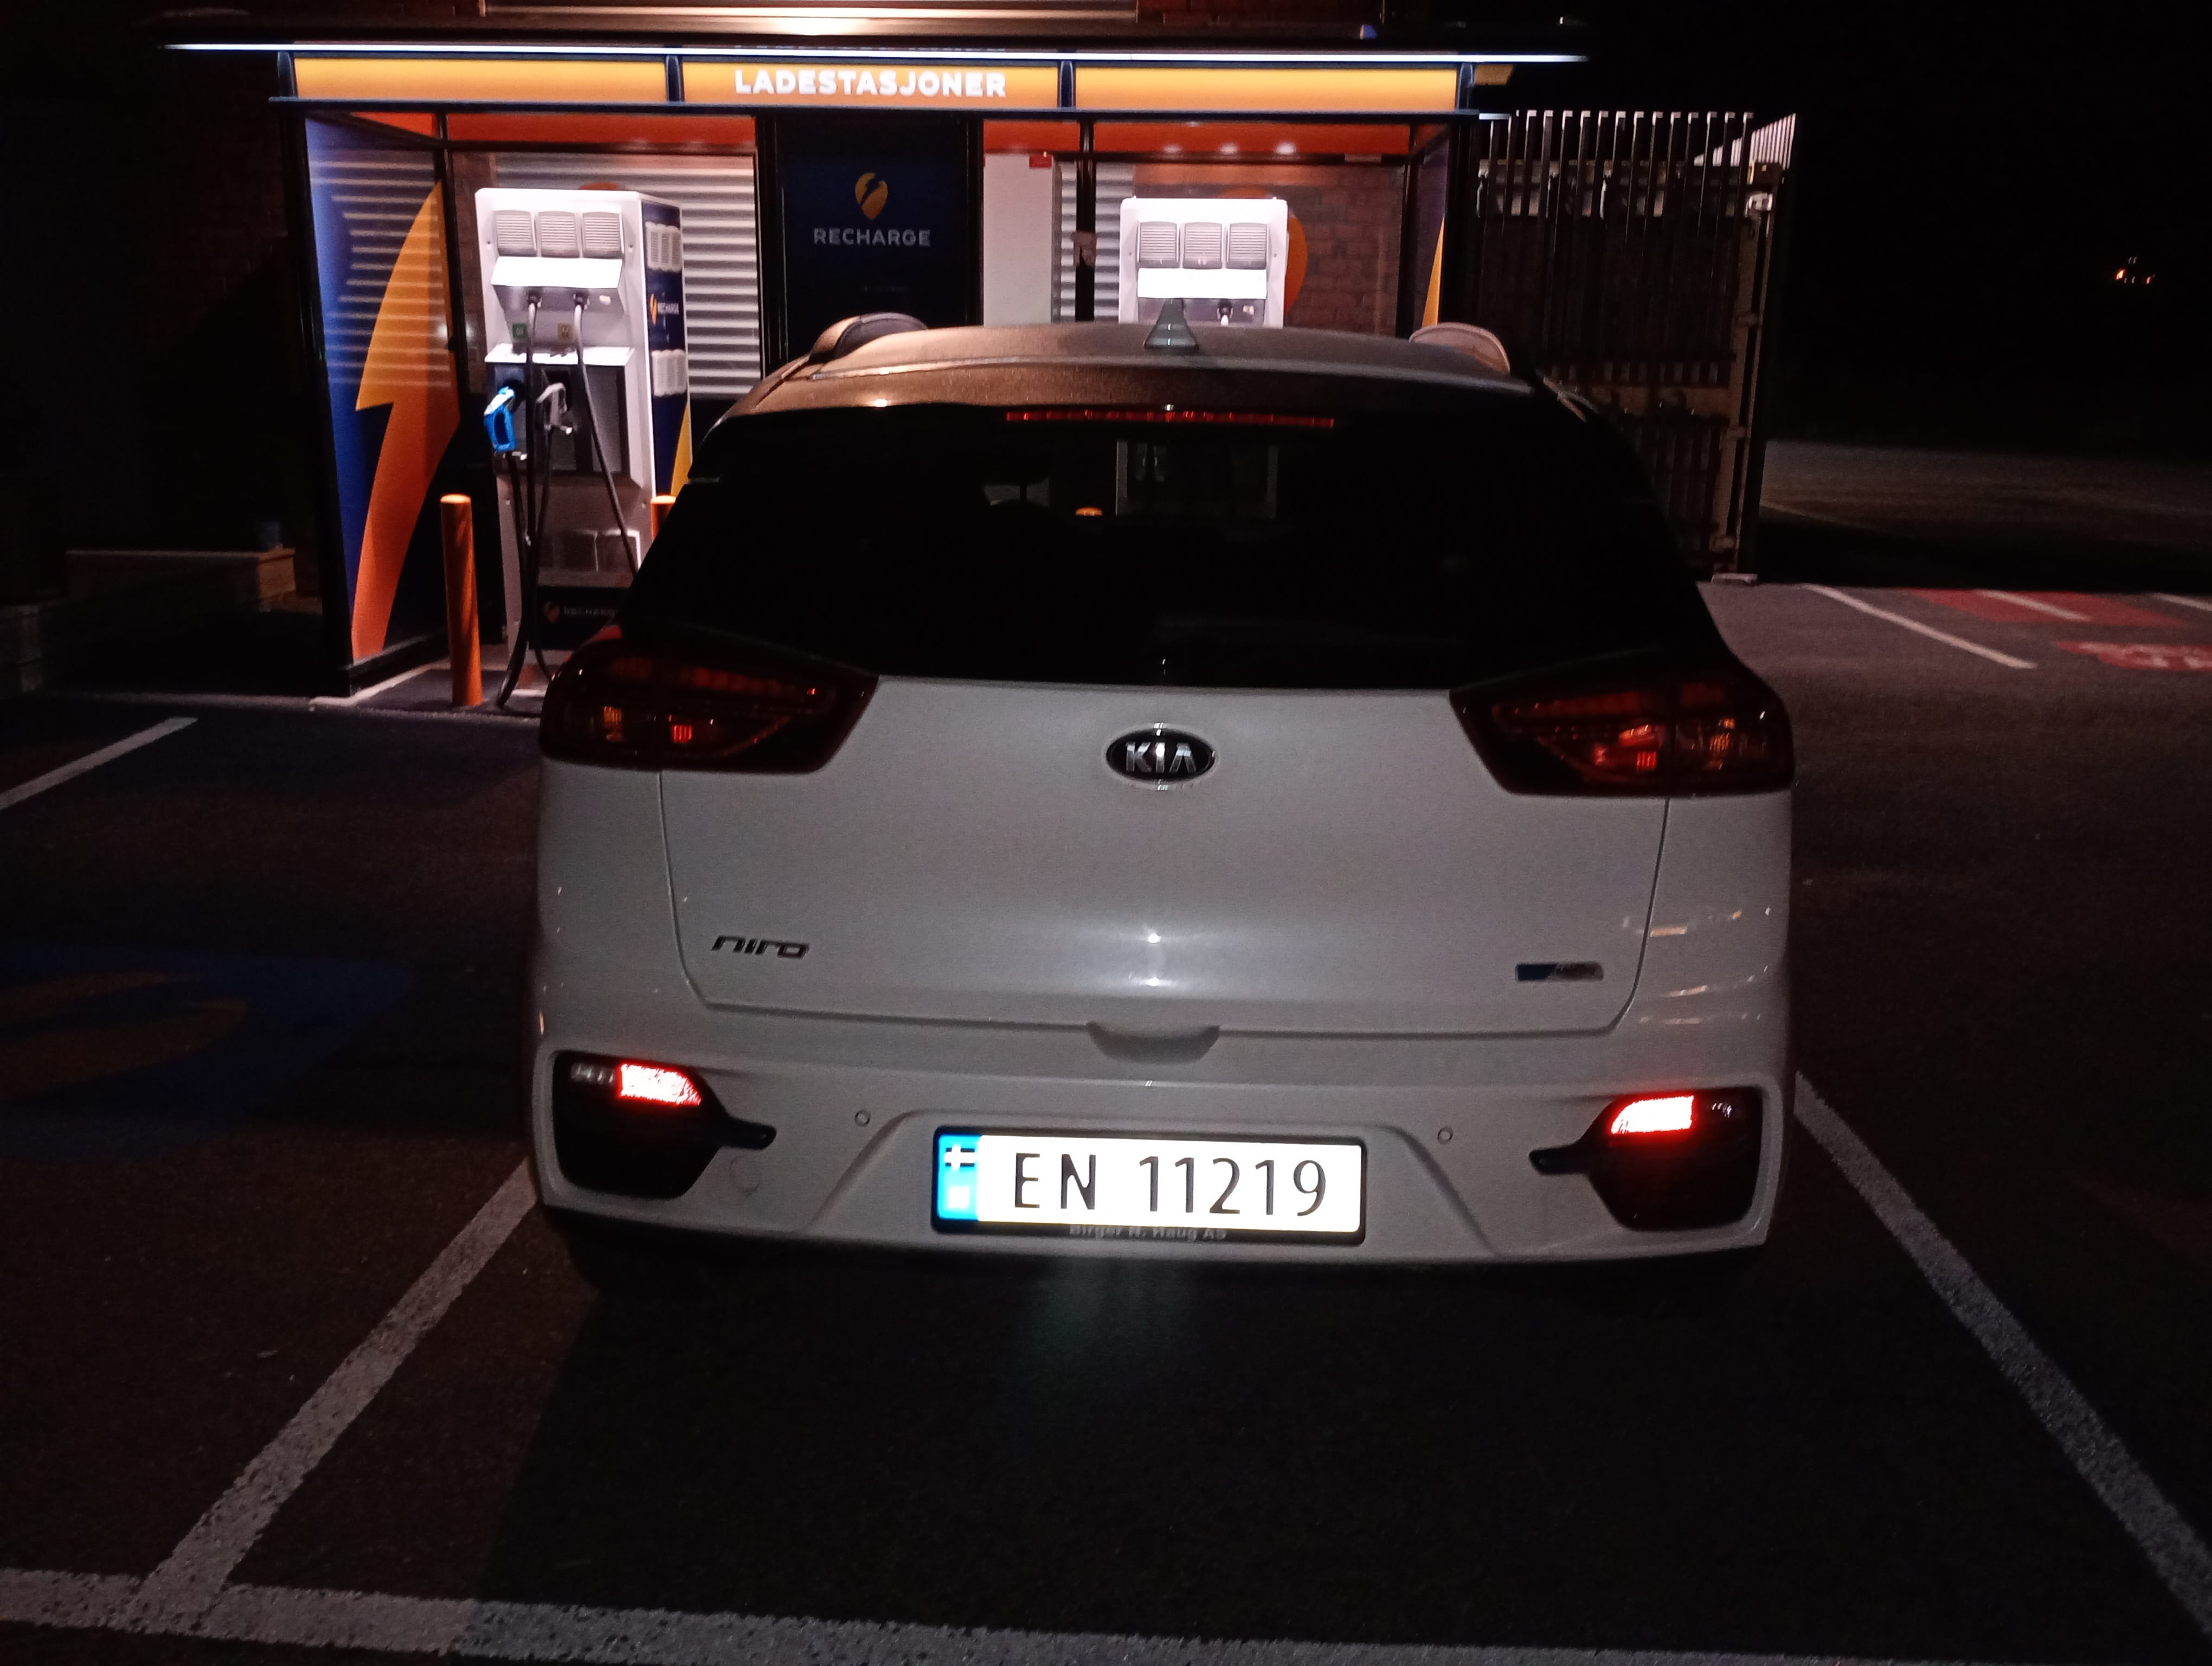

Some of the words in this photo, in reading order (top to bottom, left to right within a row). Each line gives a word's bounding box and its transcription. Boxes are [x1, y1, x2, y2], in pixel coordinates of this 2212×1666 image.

[735, 69, 1007, 98] LADESTASJONER
[814, 227, 931, 247] RECHARGE
[1126, 741, 1197, 773] KIA
[1015, 1152, 1096, 1210] EN
[1139, 1156, 1326, 1216] 11219
